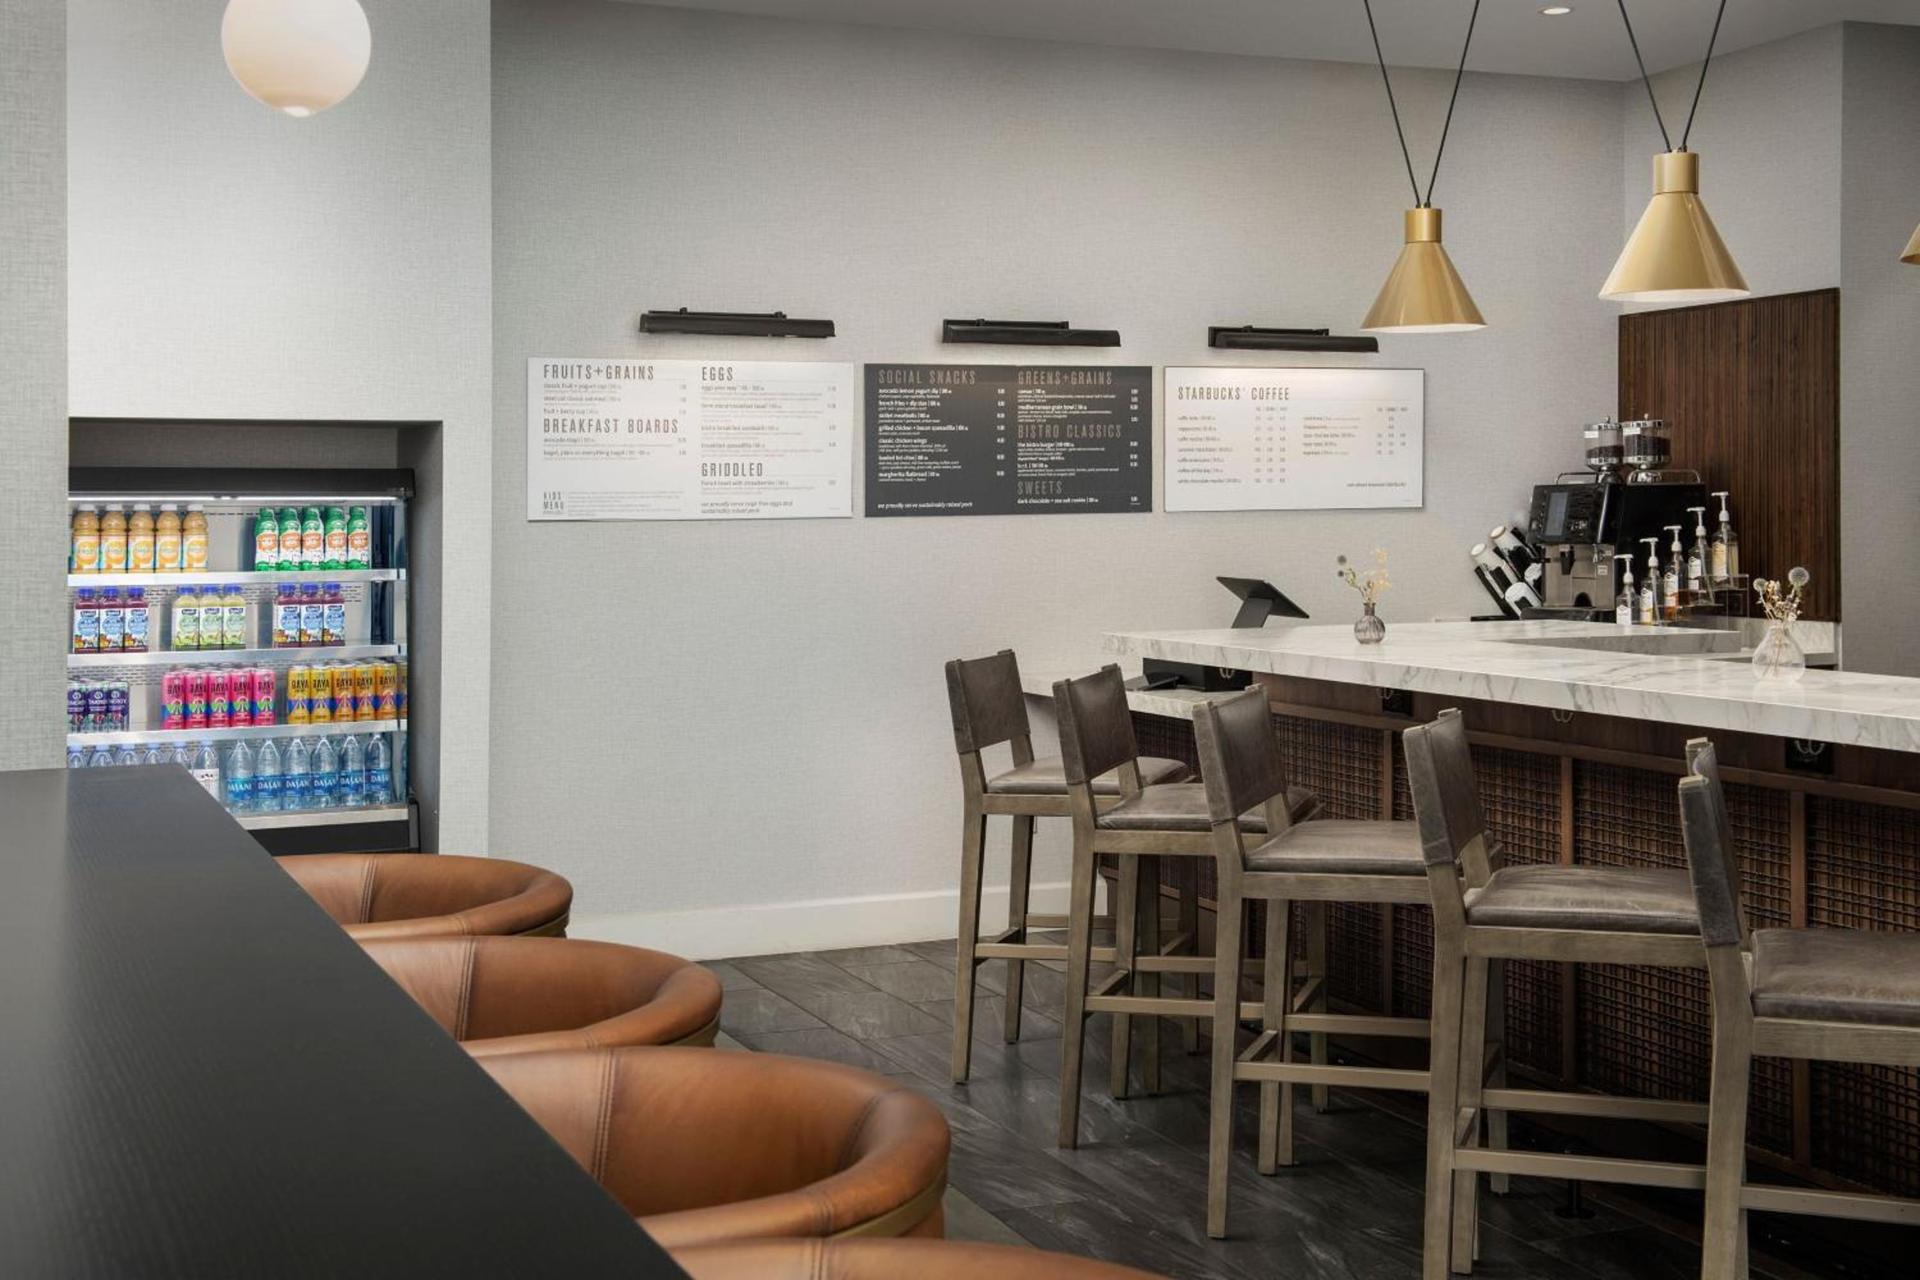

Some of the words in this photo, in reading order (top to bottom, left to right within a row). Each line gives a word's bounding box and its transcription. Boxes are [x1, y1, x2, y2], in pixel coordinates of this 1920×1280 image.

[543, 364, 655, 380] FRUITS+GRAINS
[701, 366, 733, 381] EGGS
[878, 369, 922, 384] SOCIAL
[929, 369, 976, 385] SNACKS
[1017, 370, 1112, 385] GREENS+GRAINS
[1251, 387, 1289, 401] COFFEE
[543, 418, 620, 433] BREAKFAST
[627, 418, 679, 433] BOARDS
[1018, 424, 1060, 438] BISTRO
[1066, 424, 1121, 439] CLASSICS
[701, 462, 763, 477] GRIDDLED
[1017, 480, 1063, 495] SWEETS
